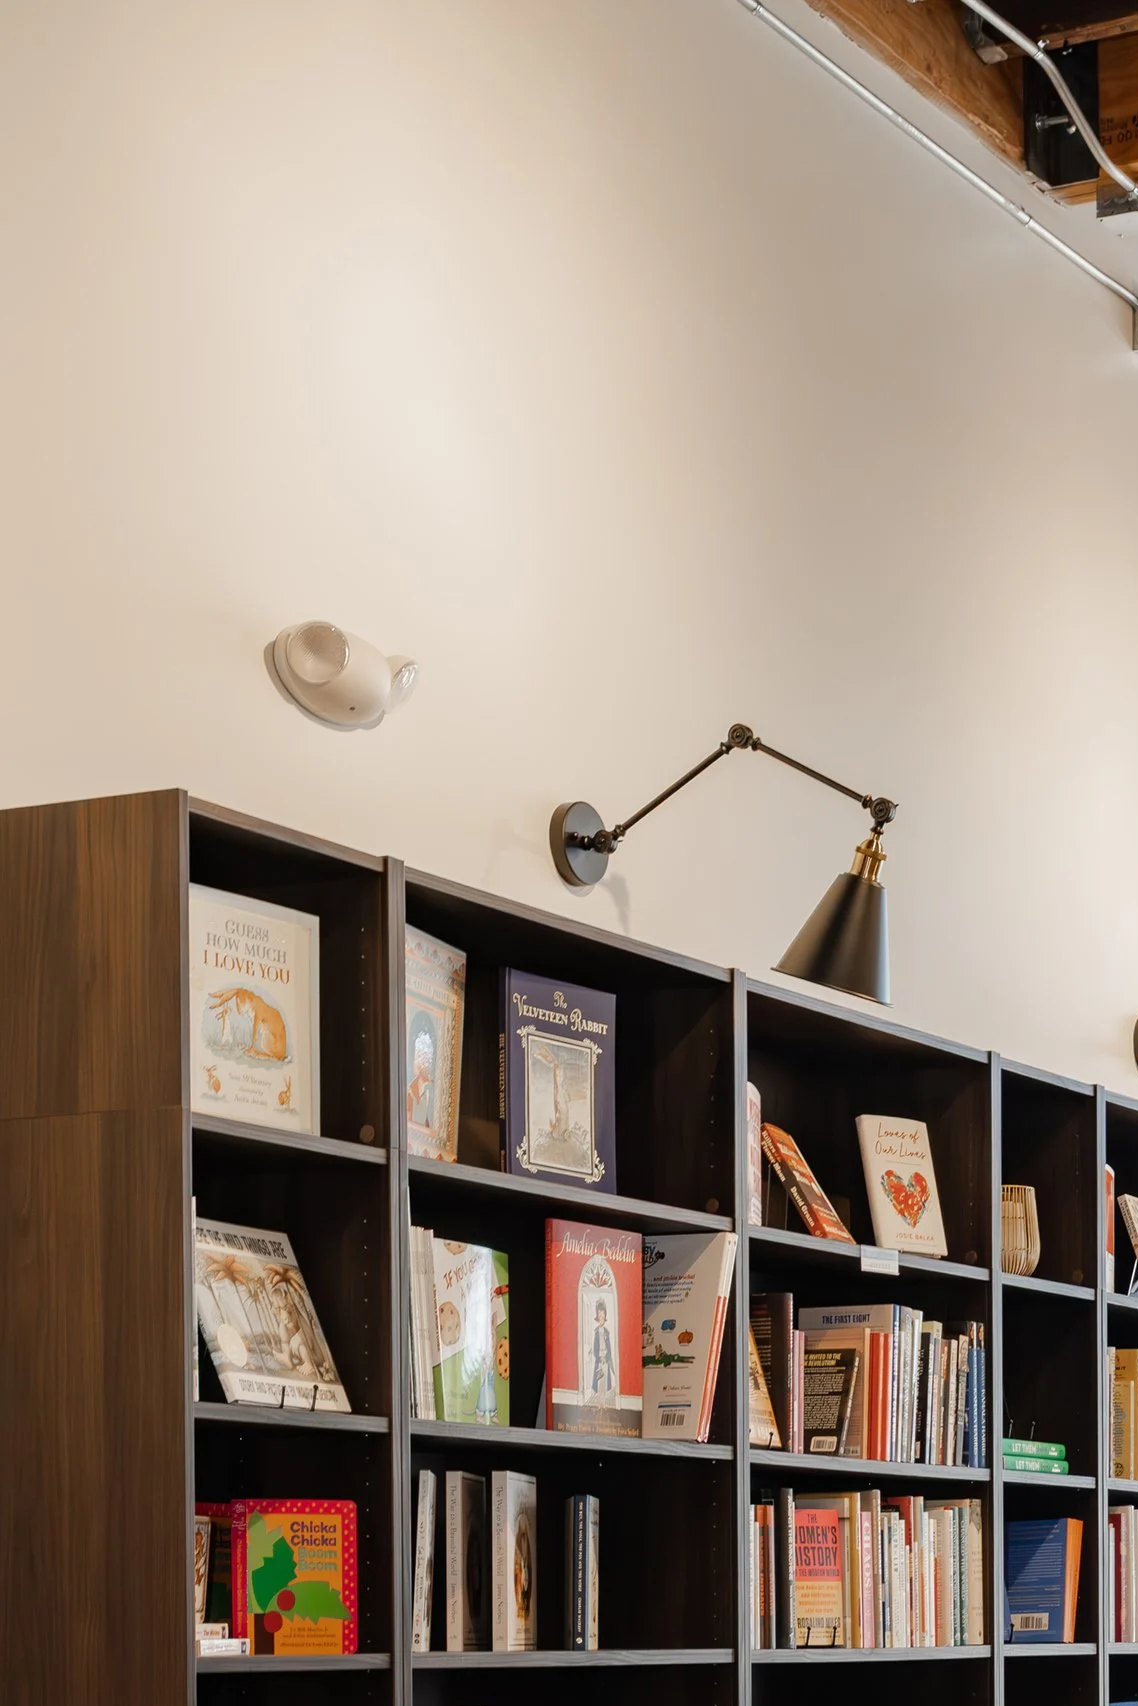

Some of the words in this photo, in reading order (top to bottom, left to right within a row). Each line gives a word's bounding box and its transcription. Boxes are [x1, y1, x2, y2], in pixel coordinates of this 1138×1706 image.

[224, 919, 270, 944] GUESS
[206, 932, 240, 952] HOW
[244, 943, 288, 965] MUCH
[203, 950, 209, 965] I
[214, 953, 256, 977] LOVE
[259, 963, 291, 985] YOU
[553, 991, 567, 1008] The
[512, 992, 569, 1026] VELVETEEN
[569, 1008, 609, 1036] RABBIT
[556, 1230, 597, 1258] Amelia
[600, 1237, 637, 1264] Bedelia
[443, 1272, 452, 1289] IF
[822, 1314, 834, 1325] THE
[834, 1314, 850, 1325] FIRST
[851, 1313, 871, 1324] EIGHT
[1012, 1443, 1020, 1453] LET
[1015, 1460, 1023, 1470] LET
[807, 1513, 818, 1524] THE
[290, 1521, 337, 1534] Chicka
[290, 1535, 337, 1547] Chicka
[298, 1547, 338, 1559] Boom
[862, 1521, 873, 1587] CHAOS
[298, 1559, 338, 1572] Boom
[797, 1617, 824, 1628] ROSALIND
